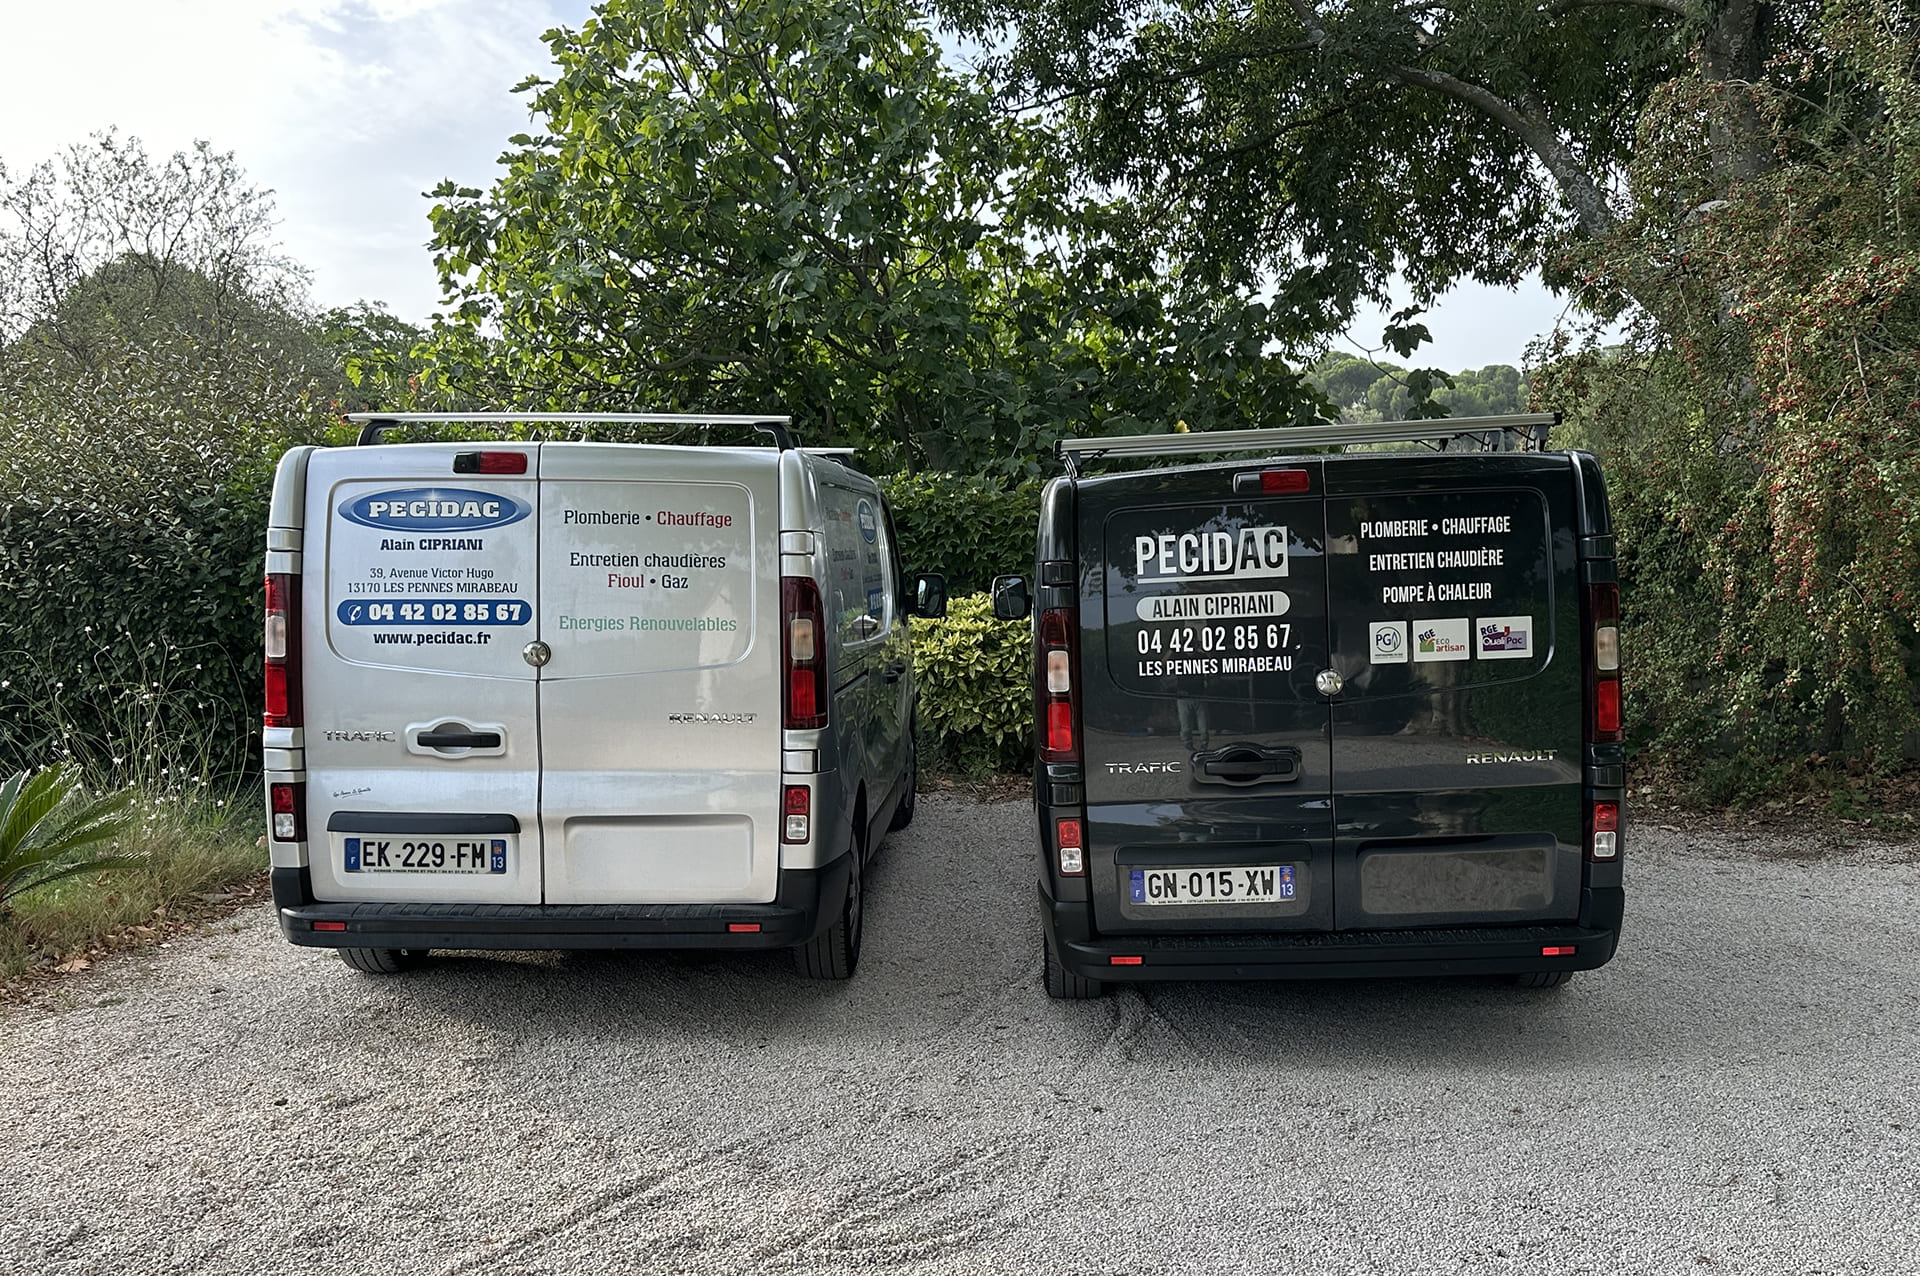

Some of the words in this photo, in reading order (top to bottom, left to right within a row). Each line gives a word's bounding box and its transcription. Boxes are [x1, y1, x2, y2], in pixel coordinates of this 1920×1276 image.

[368, 501, 500, 518] PECIDAC
[563, 510, 640, 525] Plomberie
[657, 511, 732, 528] Chauffage
[1360, 519, 1429, 539] PLOMBERIE
[1442, 516, 1511, 535] CHAUFFAGE
[380, 538, 415, 550] Alain
[419, 538, 483, 551] CIPRIANI
[1135, 529, 1284, 576] PECIDAC
[570, 552, 639, 567] Entretien
[644, 552, 726, 568] chaudières
[1369, 551, 1434, 571] ENTRETIEN
[1437, 546, 1504, 568] CHAUDIÈRE
[369, 568, 386, 579] 39,
[389, 568, 428, 578] Avenue
[431, 567, 464, 578] Victor
[466, 568, 494, 580] Hugo
[607, 573, 645, 588] Fioul
[661, 574, 689, 589] Gaz
[347, 582, 380, 593] 13170
[384, 582, 404, 593] LES
[407, 582, 453, 593] PENNES
[456, 582, 518, 593] MIRABEAU
[1383, 585, 1424, 604] POMPE
[1427, 581, 1436, 602] À
[1438, 582, 1492, 602] CHALEUR
[368, 603, 394, 621] 04
[399, 603, 425, 621] 42
[431, 603, 457, 621] 02
[463, 603, 489, 621] 85
[495, 603, 521, 621] 67
[1152, 597, 1199, 618] ALAIN
[1205, 594, 1274, 616] CIPRIANI
[559, 615, 625, 632] Energies
[629, 616, 737, 632] Renouvelables
[1480, 624, 1498, 636] RGE
[373, 631, 491, 646] www.pecidac.fr
[1137, 629, 1162, 655] 04
[1169, 627, 1194, 653] 42
[1201, 626, 1226, 651] 02
[1233, 625, 1259, 650] 85
[1266, 623, 1291, 649] 67
[1417, 628, 1436, 643] RGE
[1435, 643, 1466, 652] artisan
[1138, 661, 1163, 677] LES
[1166, 658, 1218, 675] PENNES
[1222, 655, 1292, 674] MIRABEAU
[668, 712, 758, 724] RENAULT
[322, 730, 396, 742] TRAFIC
[1466, 749, 1558, 765] RENAULT
[1104, 761, 1182, 774] TRAFIC
[350, 856, 356, 865] F
[362, 841, 485, 868] EK-229-FM
[492, 856, 504, 869] 13
[1148, 869, 1274, 899] GN-015-XW
[1281, 883, 1294, 896] 13
[1135, 889, 1140, 898] F
